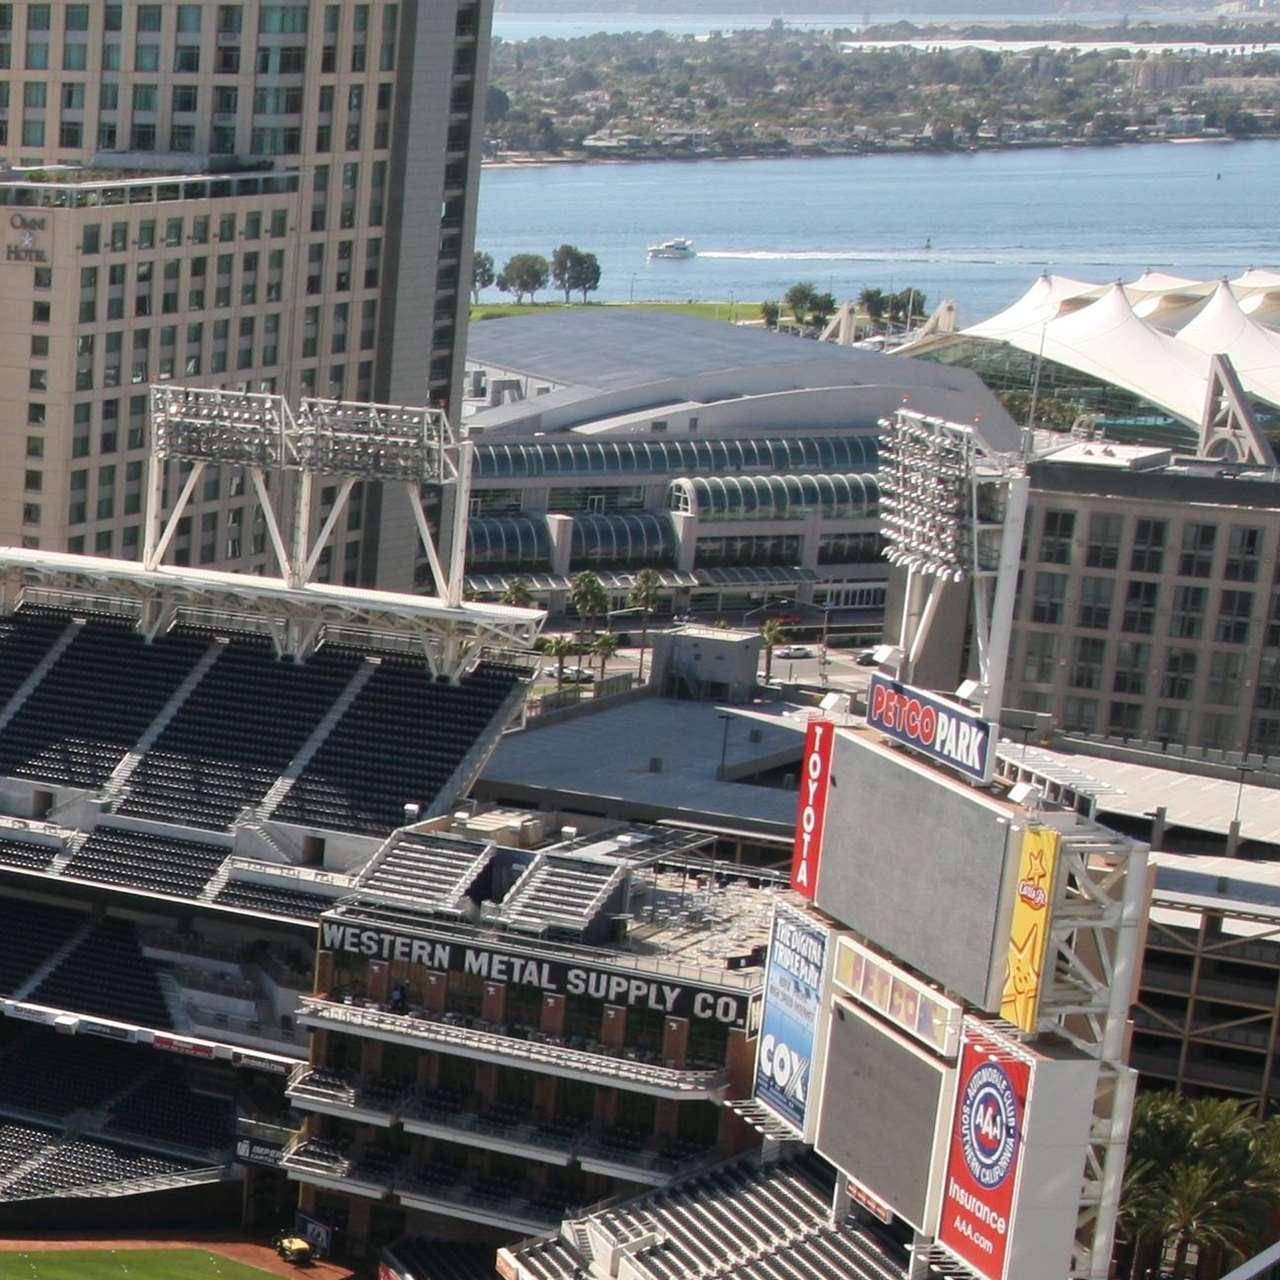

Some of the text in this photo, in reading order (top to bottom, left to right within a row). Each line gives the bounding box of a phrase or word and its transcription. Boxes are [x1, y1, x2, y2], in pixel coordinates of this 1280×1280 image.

[7, 244, 46, 262] HOTEL
[872, 684, 984, 770] PETCO PARK
[797, 726, 823, 887] TOYOTA
[323, 922, 450, 970] WESTERN
[464, 949, 557, 990] METAL
[566, 968, 681, 1012] SUPPLY
[693, 992, 744, 1026] CO.
[760, 1034, 808, 1101] COX
[975, 1104, 1001, 1140] AAA
[1003, 1091, 1015, 1127] CLUB
[961, 1104, 1015, 1184] SOUTHERN CALIFORNIA
[948, 1176, 1006, 1235] Insurance
[953, 1216, 994, 1255] AAA.com
